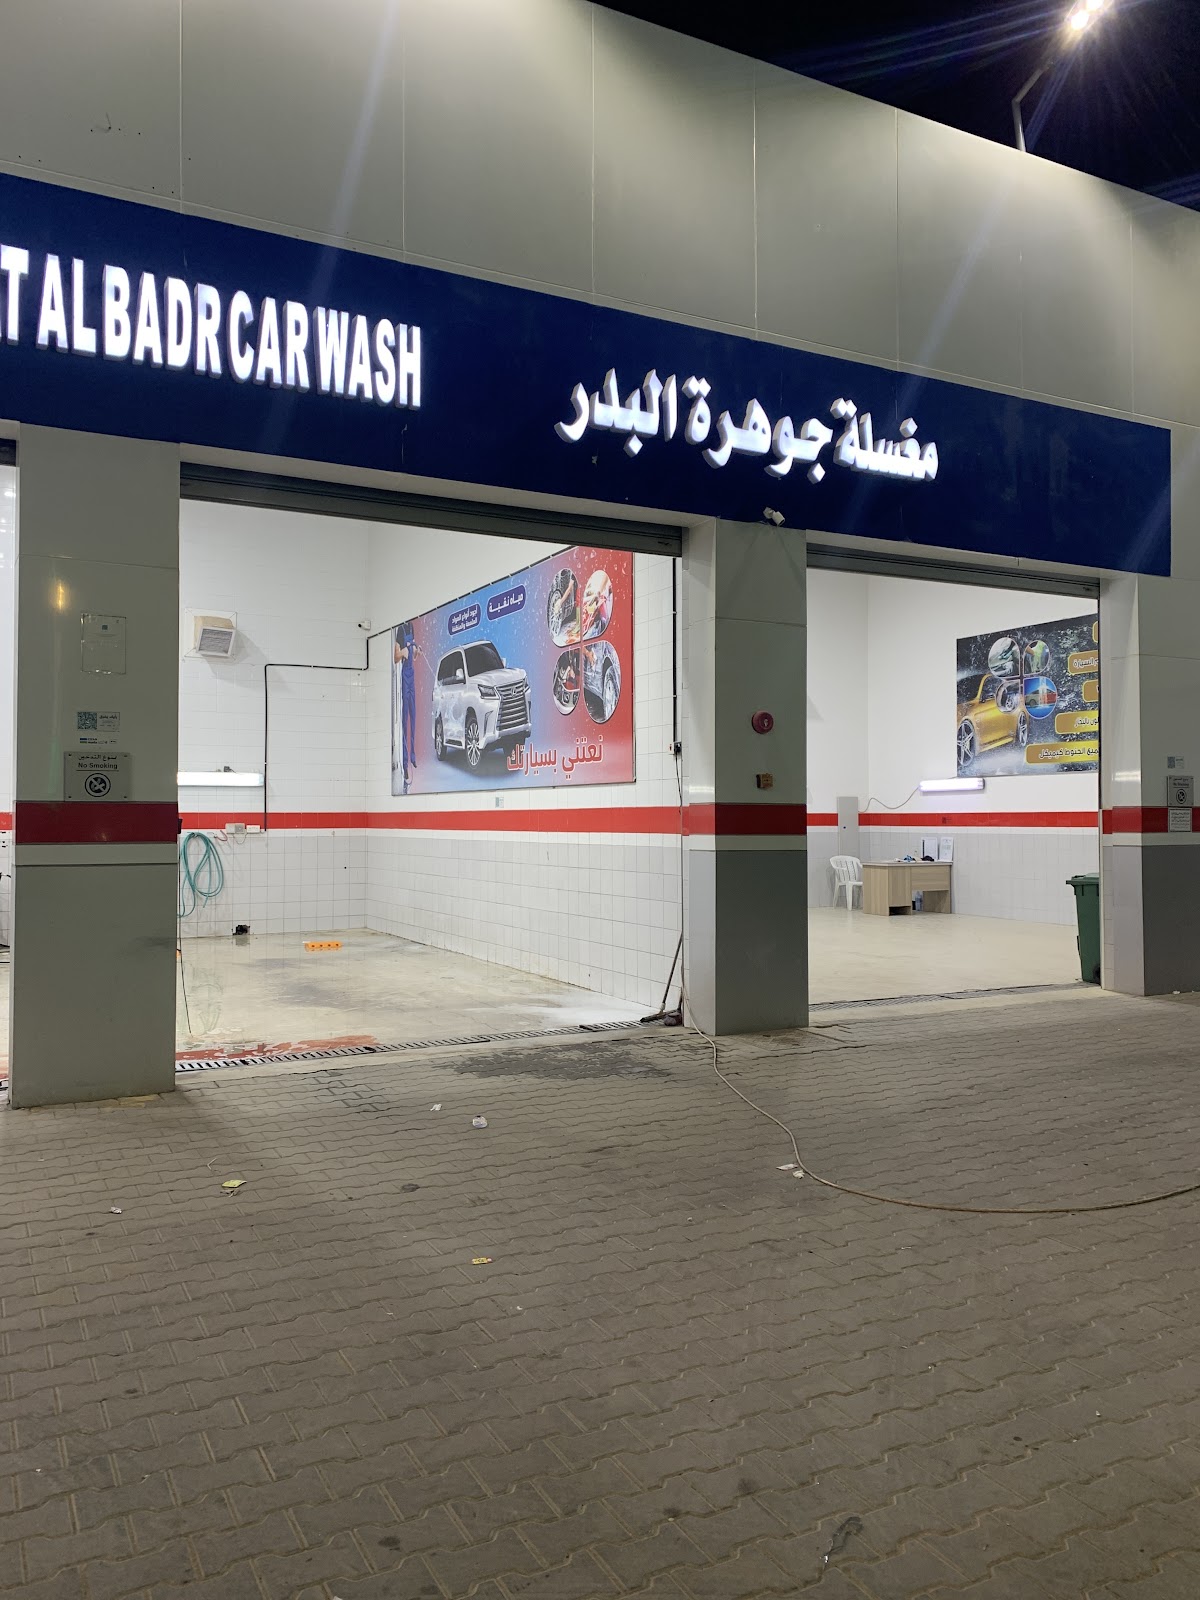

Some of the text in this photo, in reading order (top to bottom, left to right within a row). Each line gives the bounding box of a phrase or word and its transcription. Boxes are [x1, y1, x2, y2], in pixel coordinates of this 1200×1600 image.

[0, 243, 422, 410] T AL BADR CAR WASH
[554, 367, 939, 484] مغسلة جوهرة البدر
[489, 593, 523, 612] مياه نقية
[506, 734, 603, 780] نعتني بسيارتك
